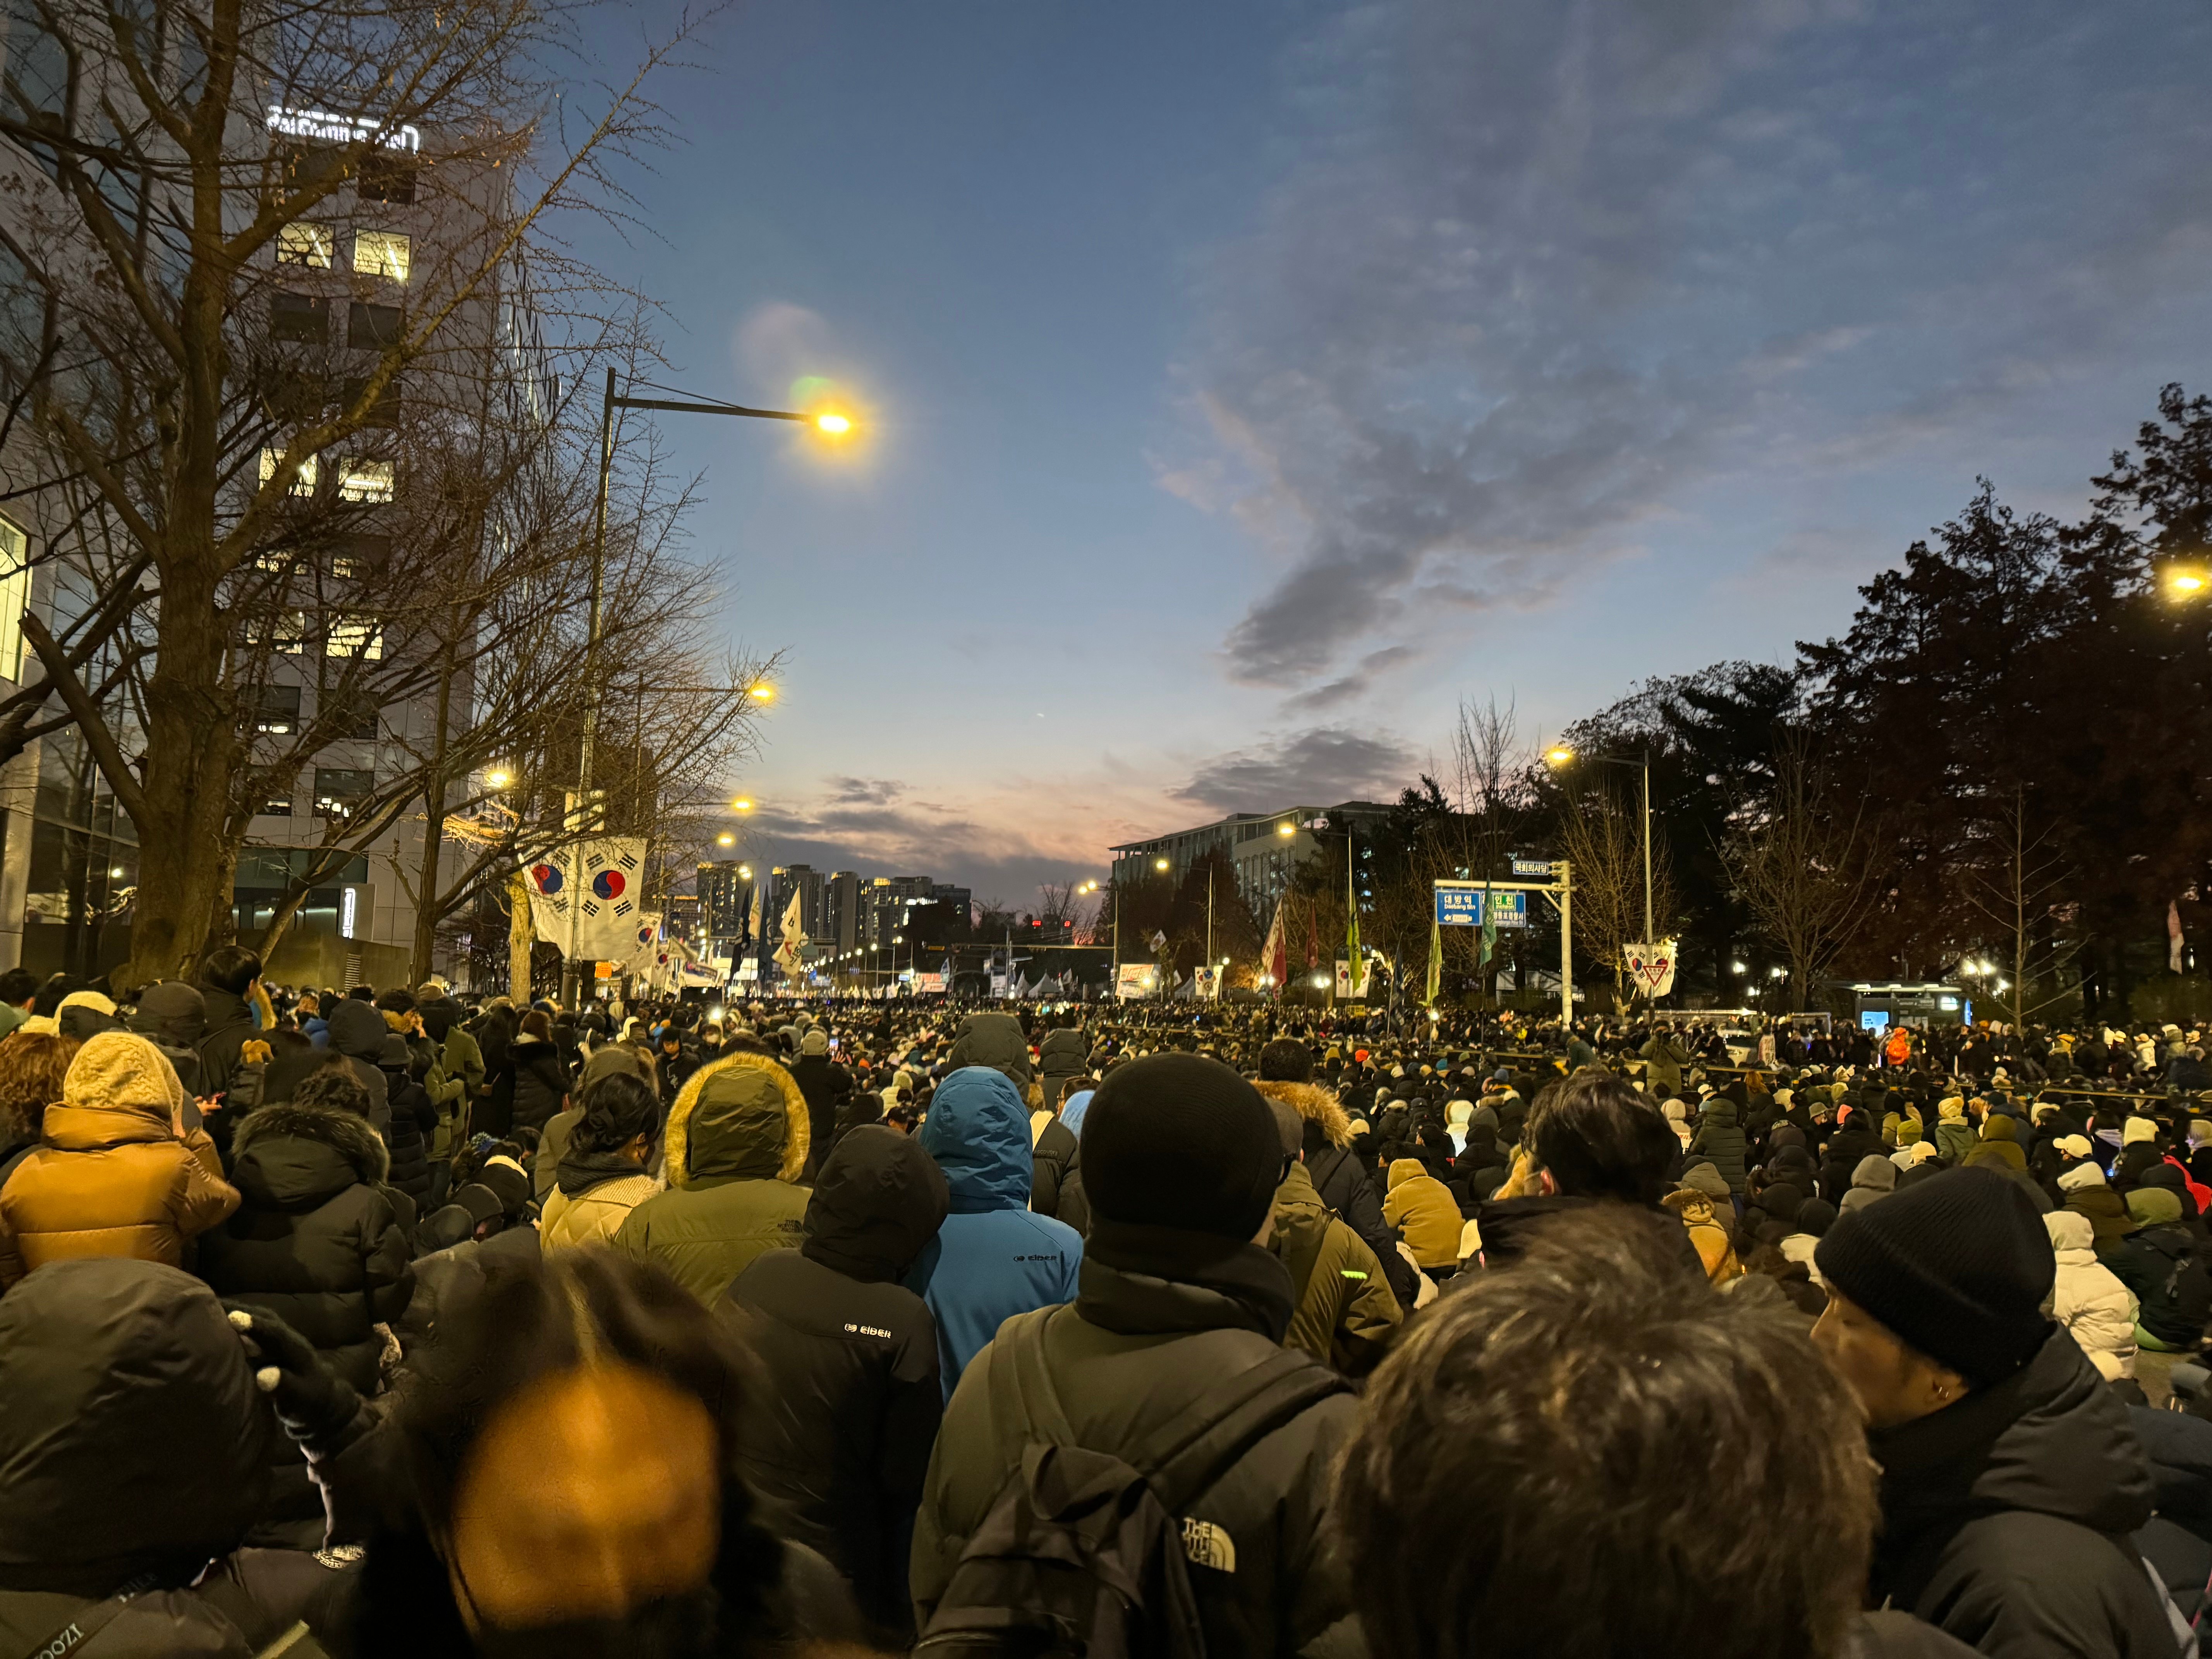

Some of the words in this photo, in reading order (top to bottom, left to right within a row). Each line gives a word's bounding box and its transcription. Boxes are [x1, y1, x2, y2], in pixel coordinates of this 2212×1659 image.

[1515, 862, 1547, 873] 국회의사당
[1444, 894, 1472, 905] 대방역
[1495, 895, 1513, 905] 인천
[860, 1326, 891, 1338] EIDER
[34, 1623, 84, 1659] OOZI
